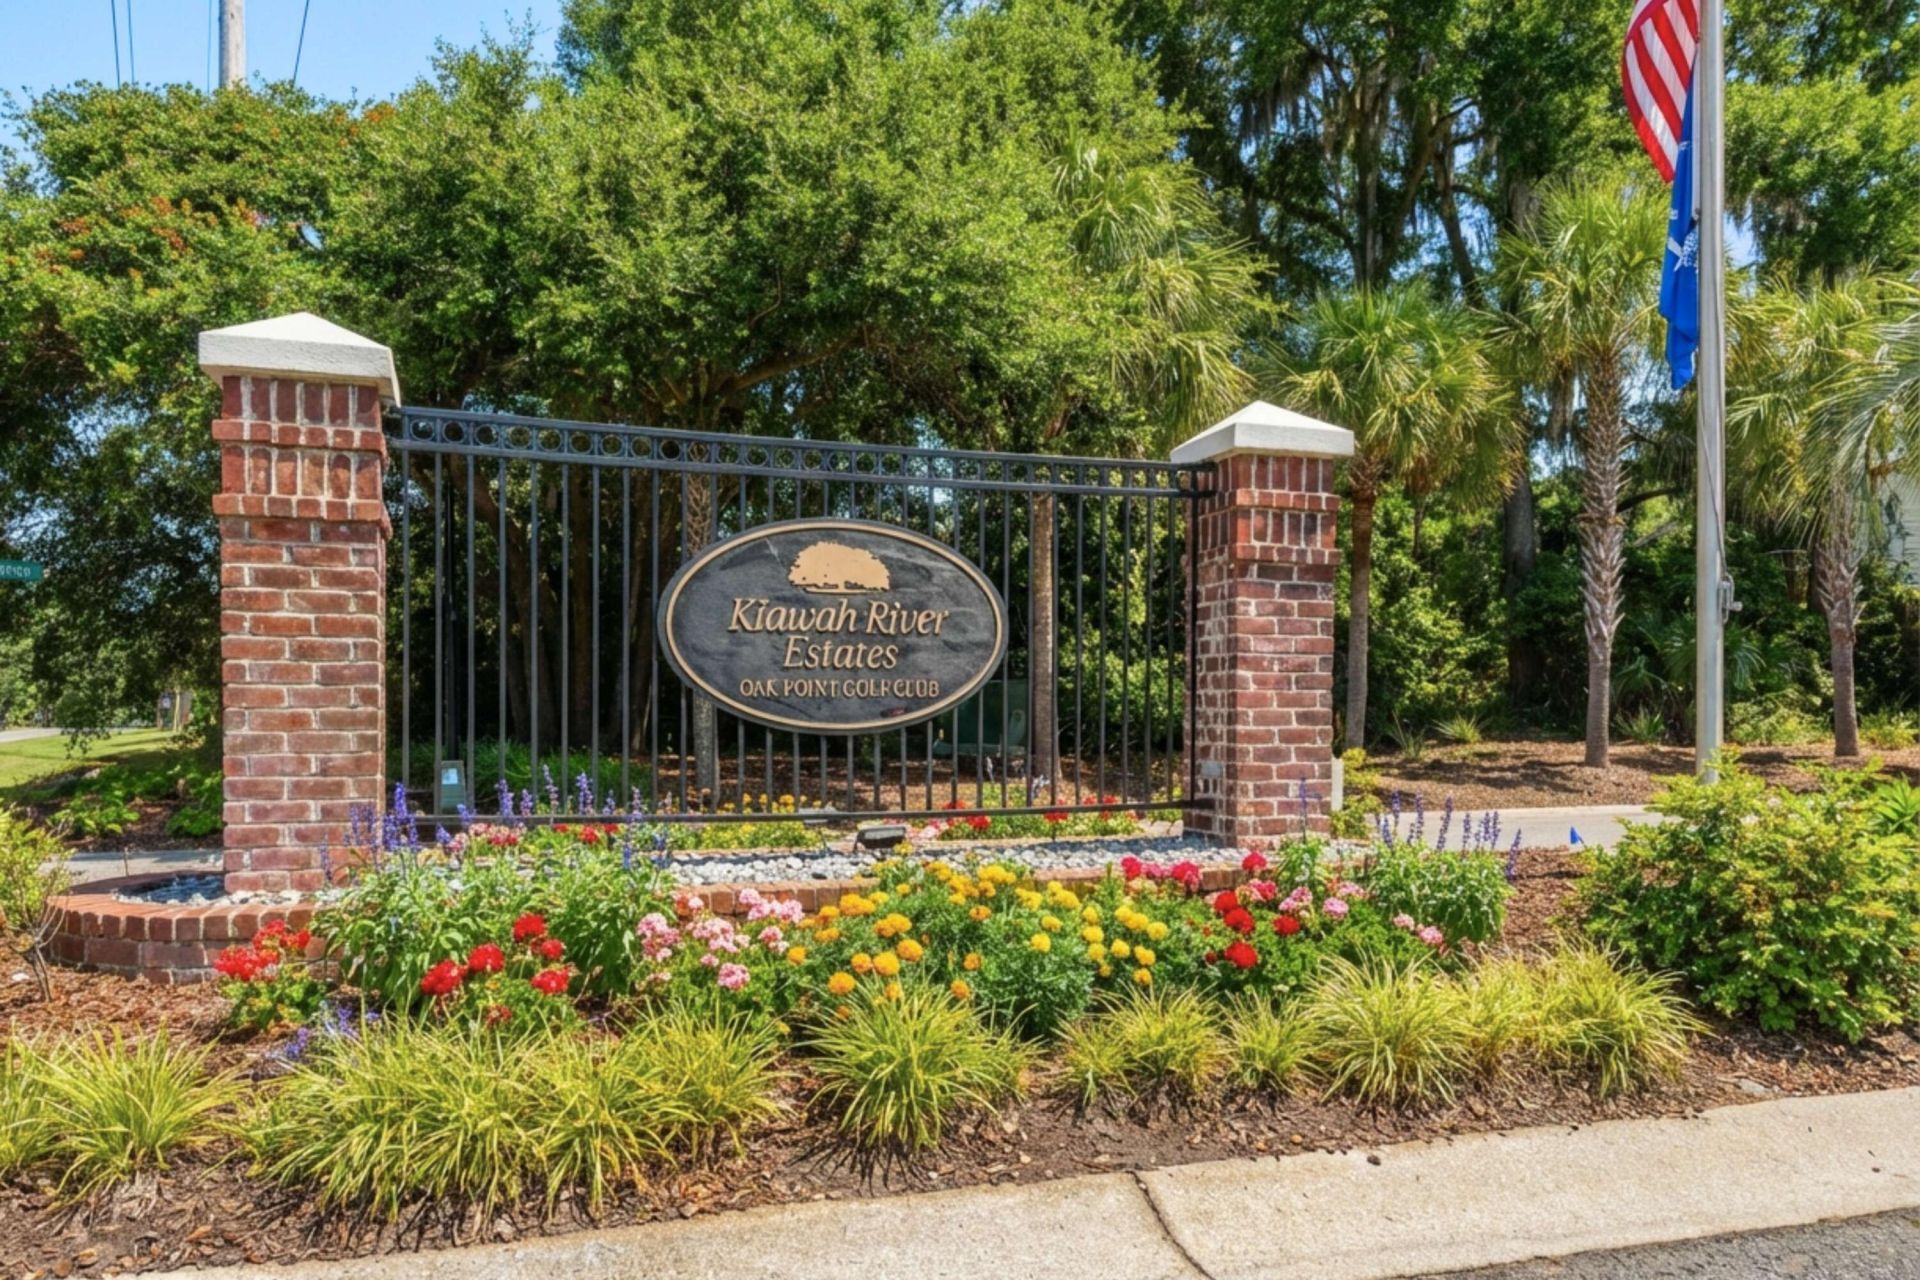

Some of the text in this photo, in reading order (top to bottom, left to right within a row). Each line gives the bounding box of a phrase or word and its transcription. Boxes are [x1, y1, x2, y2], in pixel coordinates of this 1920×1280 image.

[727, 598, 949, 635] Kiawah River
[784, 635, 899, 669] Estates
[740, 678, 939, 698] OAK POINT GOLF CLUB
